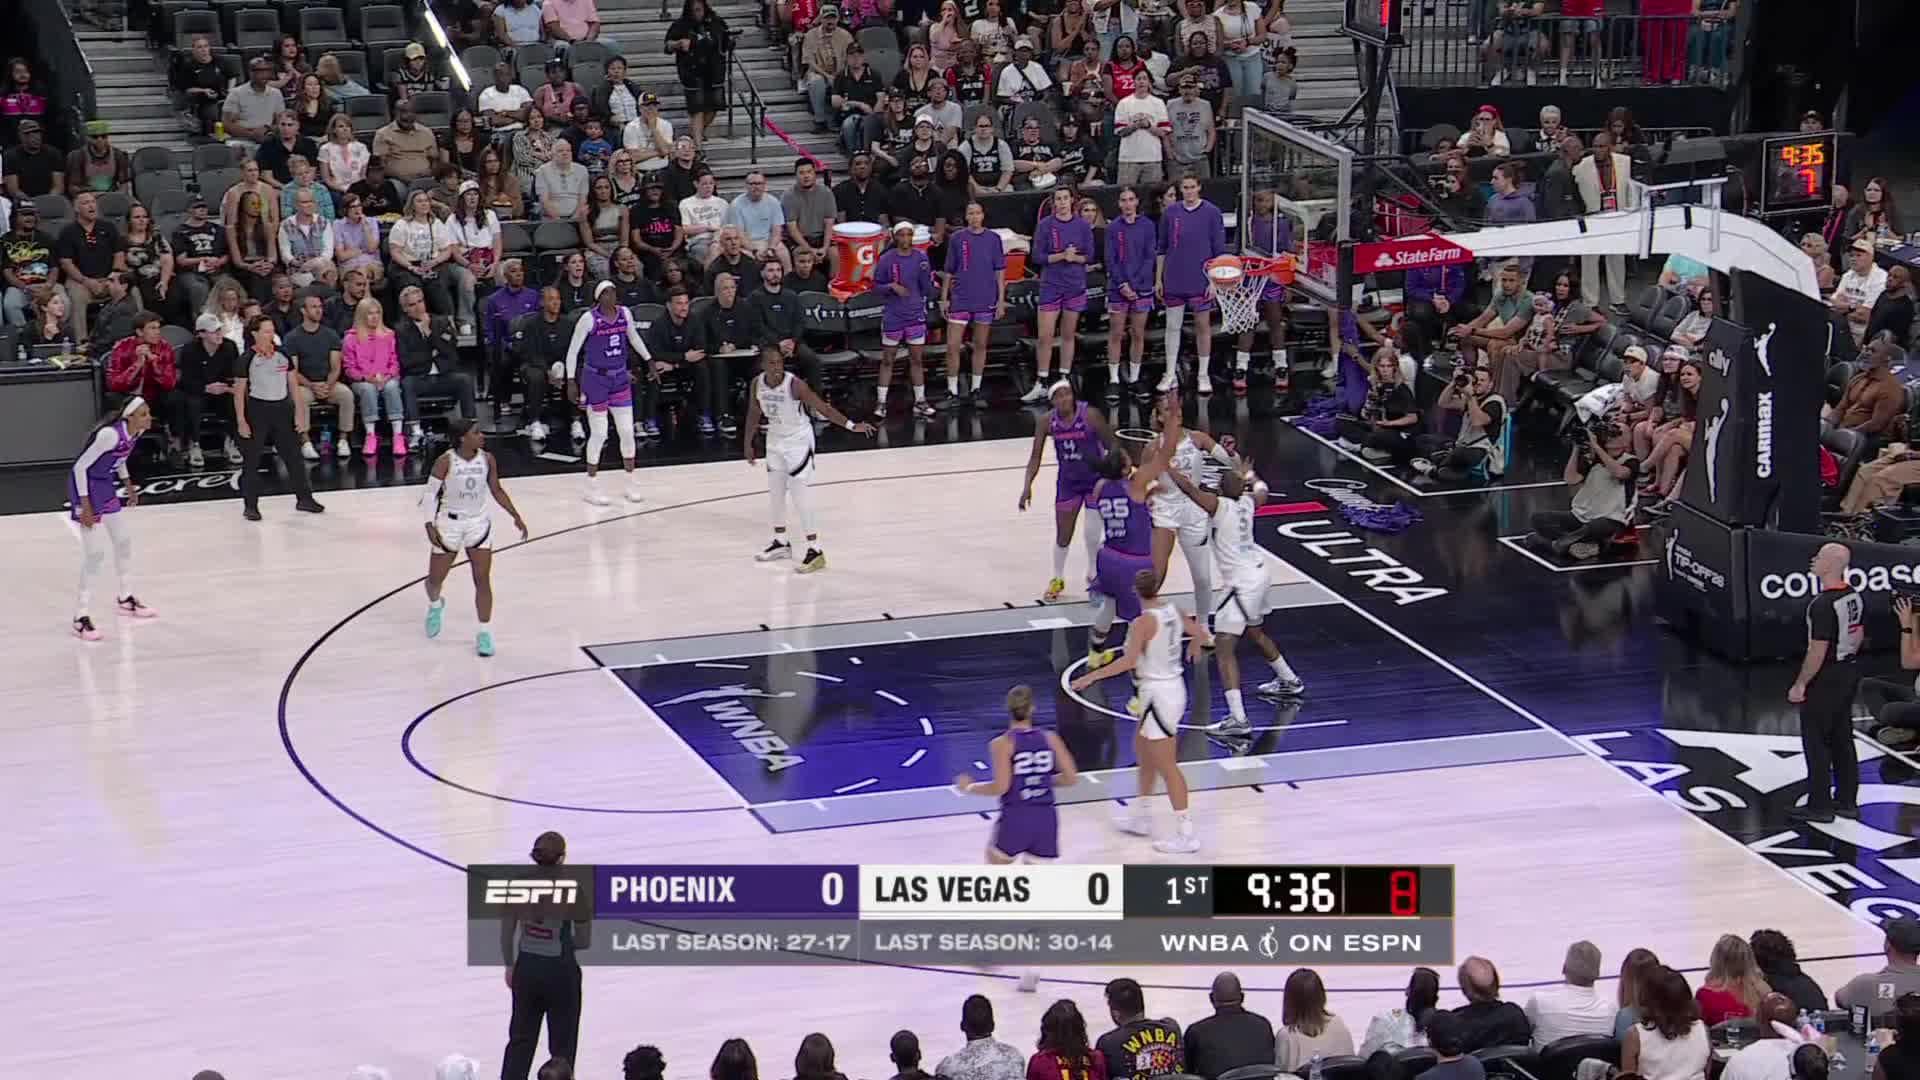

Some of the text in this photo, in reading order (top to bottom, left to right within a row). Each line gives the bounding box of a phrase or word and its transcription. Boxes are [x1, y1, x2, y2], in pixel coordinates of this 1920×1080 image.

[1781, 143, 1825, 167] 9:35
[1799, 168, 1817, 195] 7
[193, 240, 213, 251] 22
[856, 244, 874, 265] G
[609, 334, 621, 347] 2
[464, 476, 477, 491] 0
[1098, 497, 1130, 520] 25
[1276, 519, 1449, 606] ULTRA
[702, 698, 807, 772] WNBA
[1013, 750, 1054, 776] 29
[1568, 730, 1749, 813] LAS
[1122, 1028, 1179, 1056] WNBA
